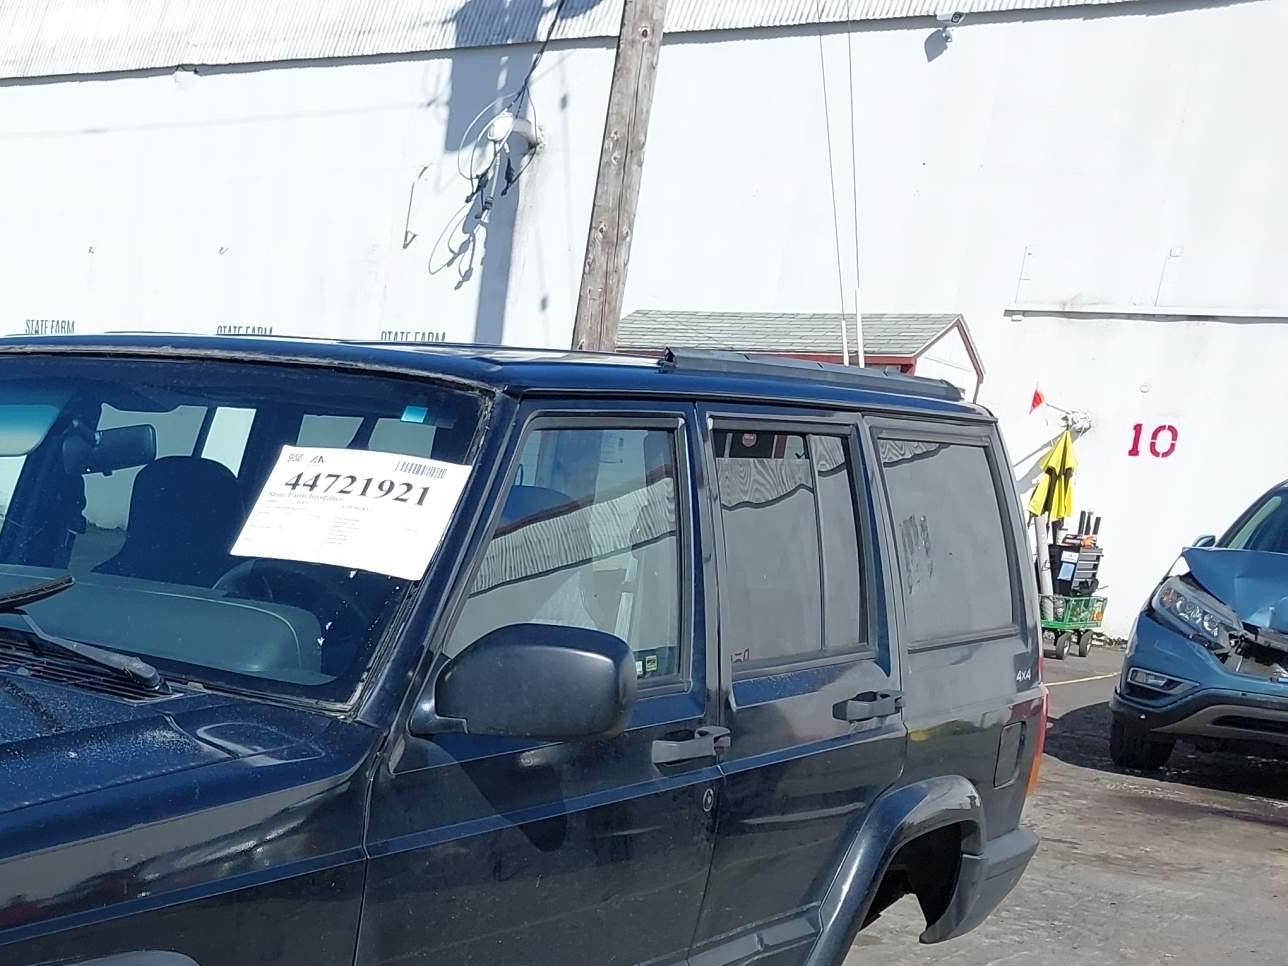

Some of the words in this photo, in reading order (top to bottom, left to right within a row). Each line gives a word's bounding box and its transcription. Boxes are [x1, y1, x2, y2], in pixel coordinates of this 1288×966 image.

[25, 319, 48, 335] STATE
[51, 319, 75, 335] FARM
[1128, 423, 1178, 457] 10
[285, 472, 430, 505] 44721921
